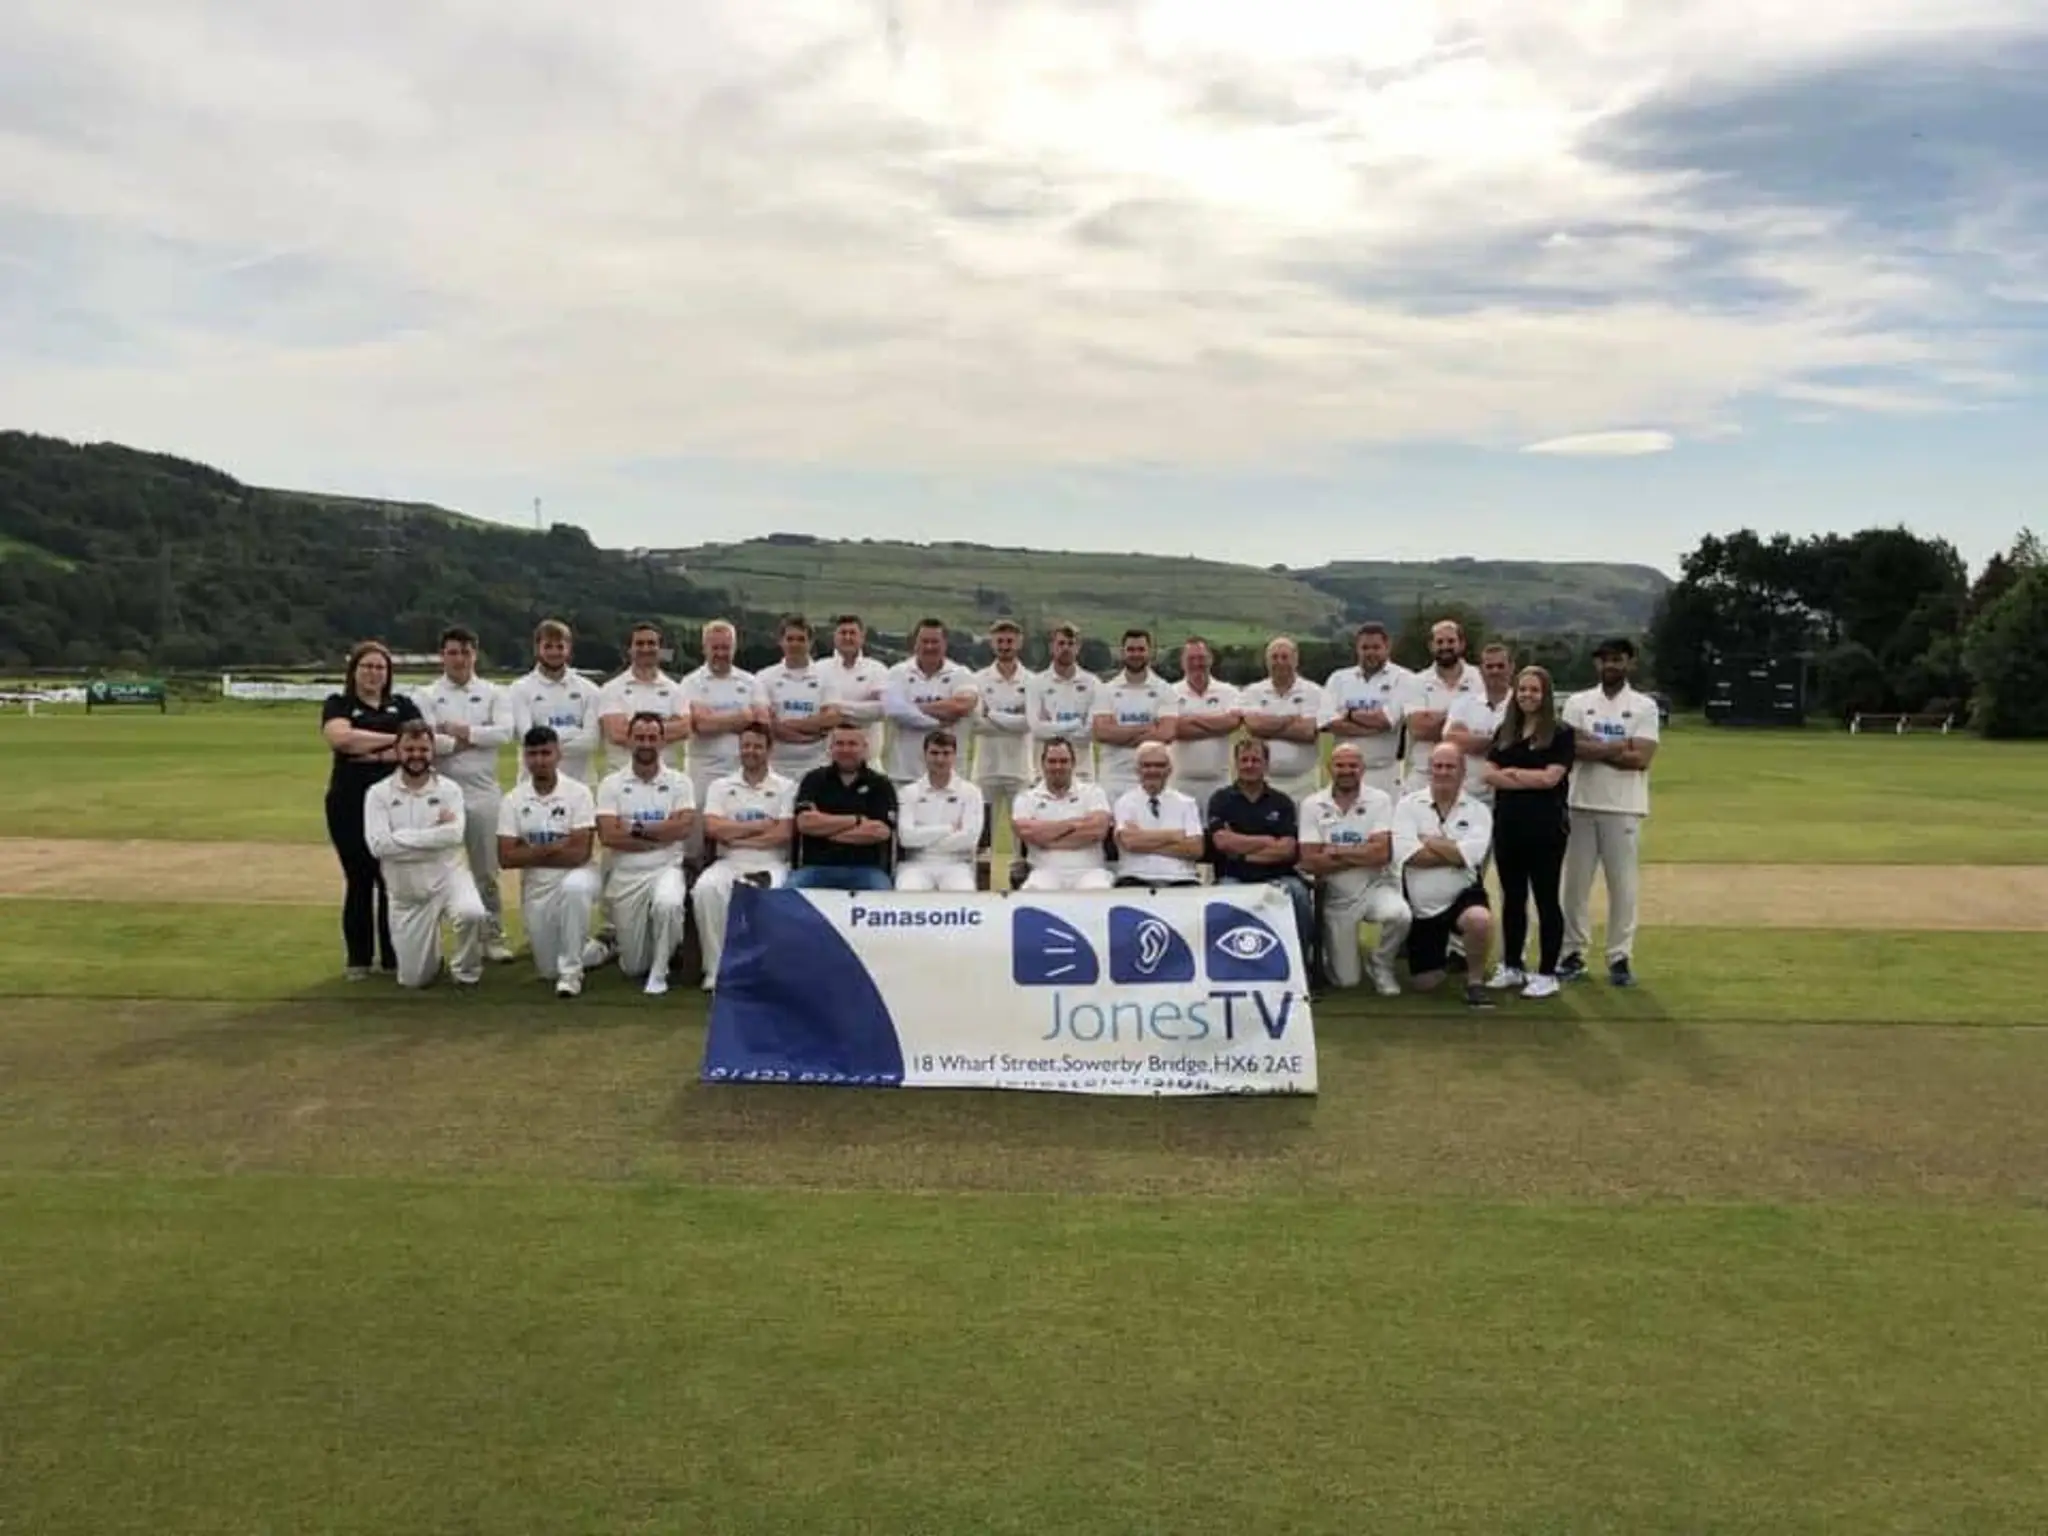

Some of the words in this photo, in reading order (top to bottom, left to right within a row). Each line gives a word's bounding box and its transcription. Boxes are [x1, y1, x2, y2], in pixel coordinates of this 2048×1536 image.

[850, 905, 983, 926] Panasonic
[1041, 990, 1293, 1042] JonesTV
[913, 1055, 934, 1073] 18
[939, 1053, 996, 1073] Wharf
[1263, 1055, 1304, 1074] 2AE
